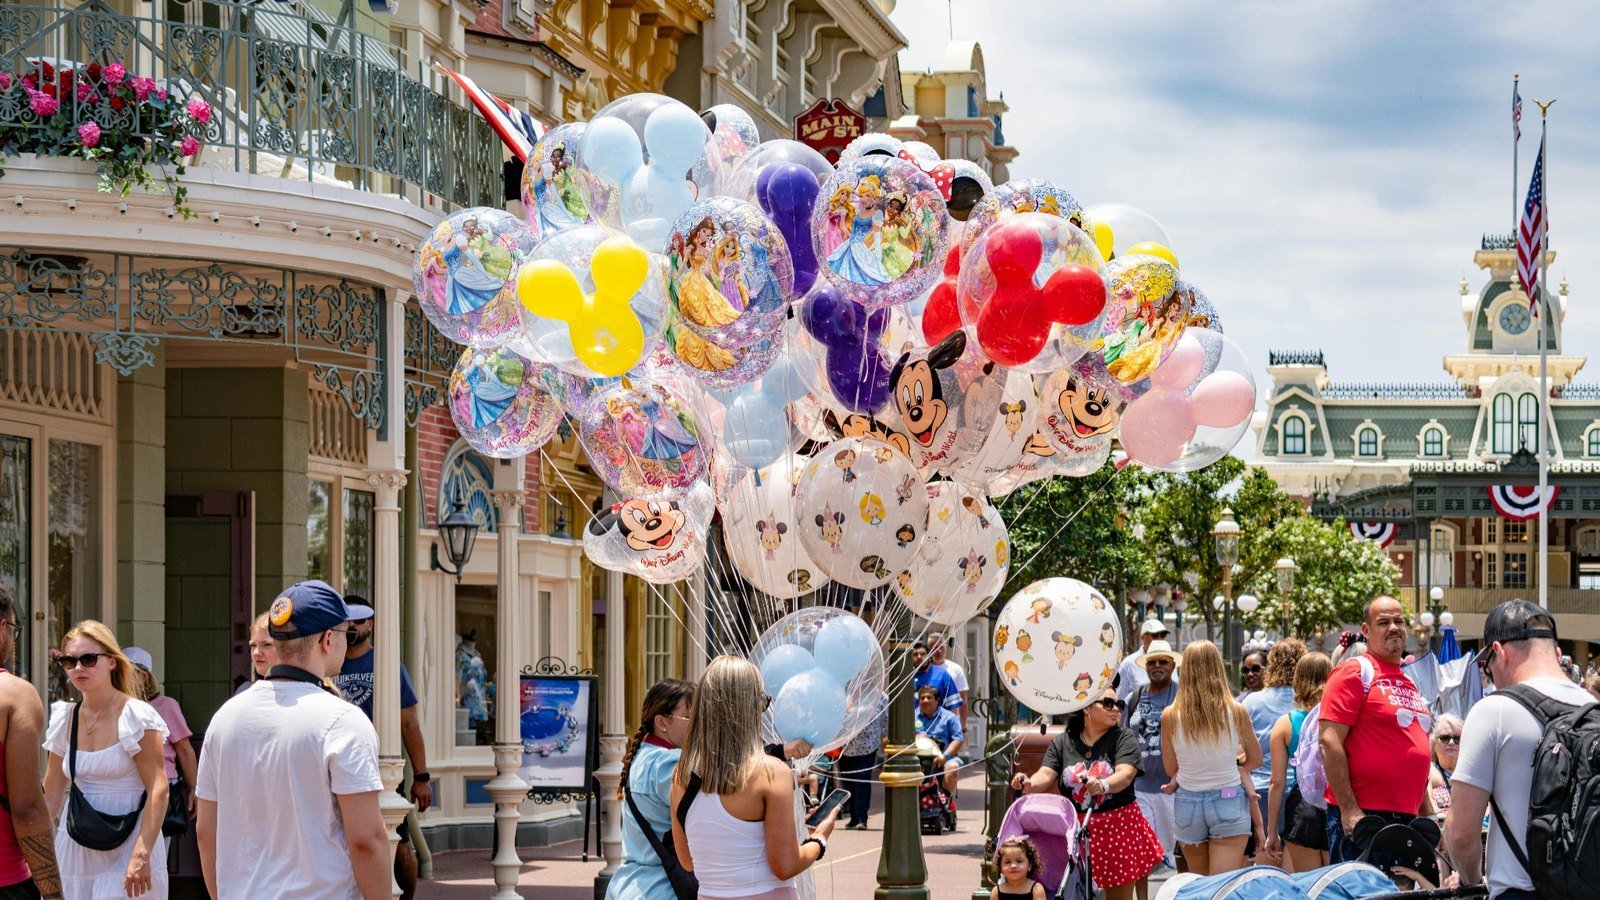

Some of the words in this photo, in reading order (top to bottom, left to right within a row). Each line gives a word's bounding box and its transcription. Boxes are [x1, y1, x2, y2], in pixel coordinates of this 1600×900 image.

[802, 116, 851, 137] MAIN
[641, 557, 657, 568] Walt
[657, 550, 685, 566] Disney
